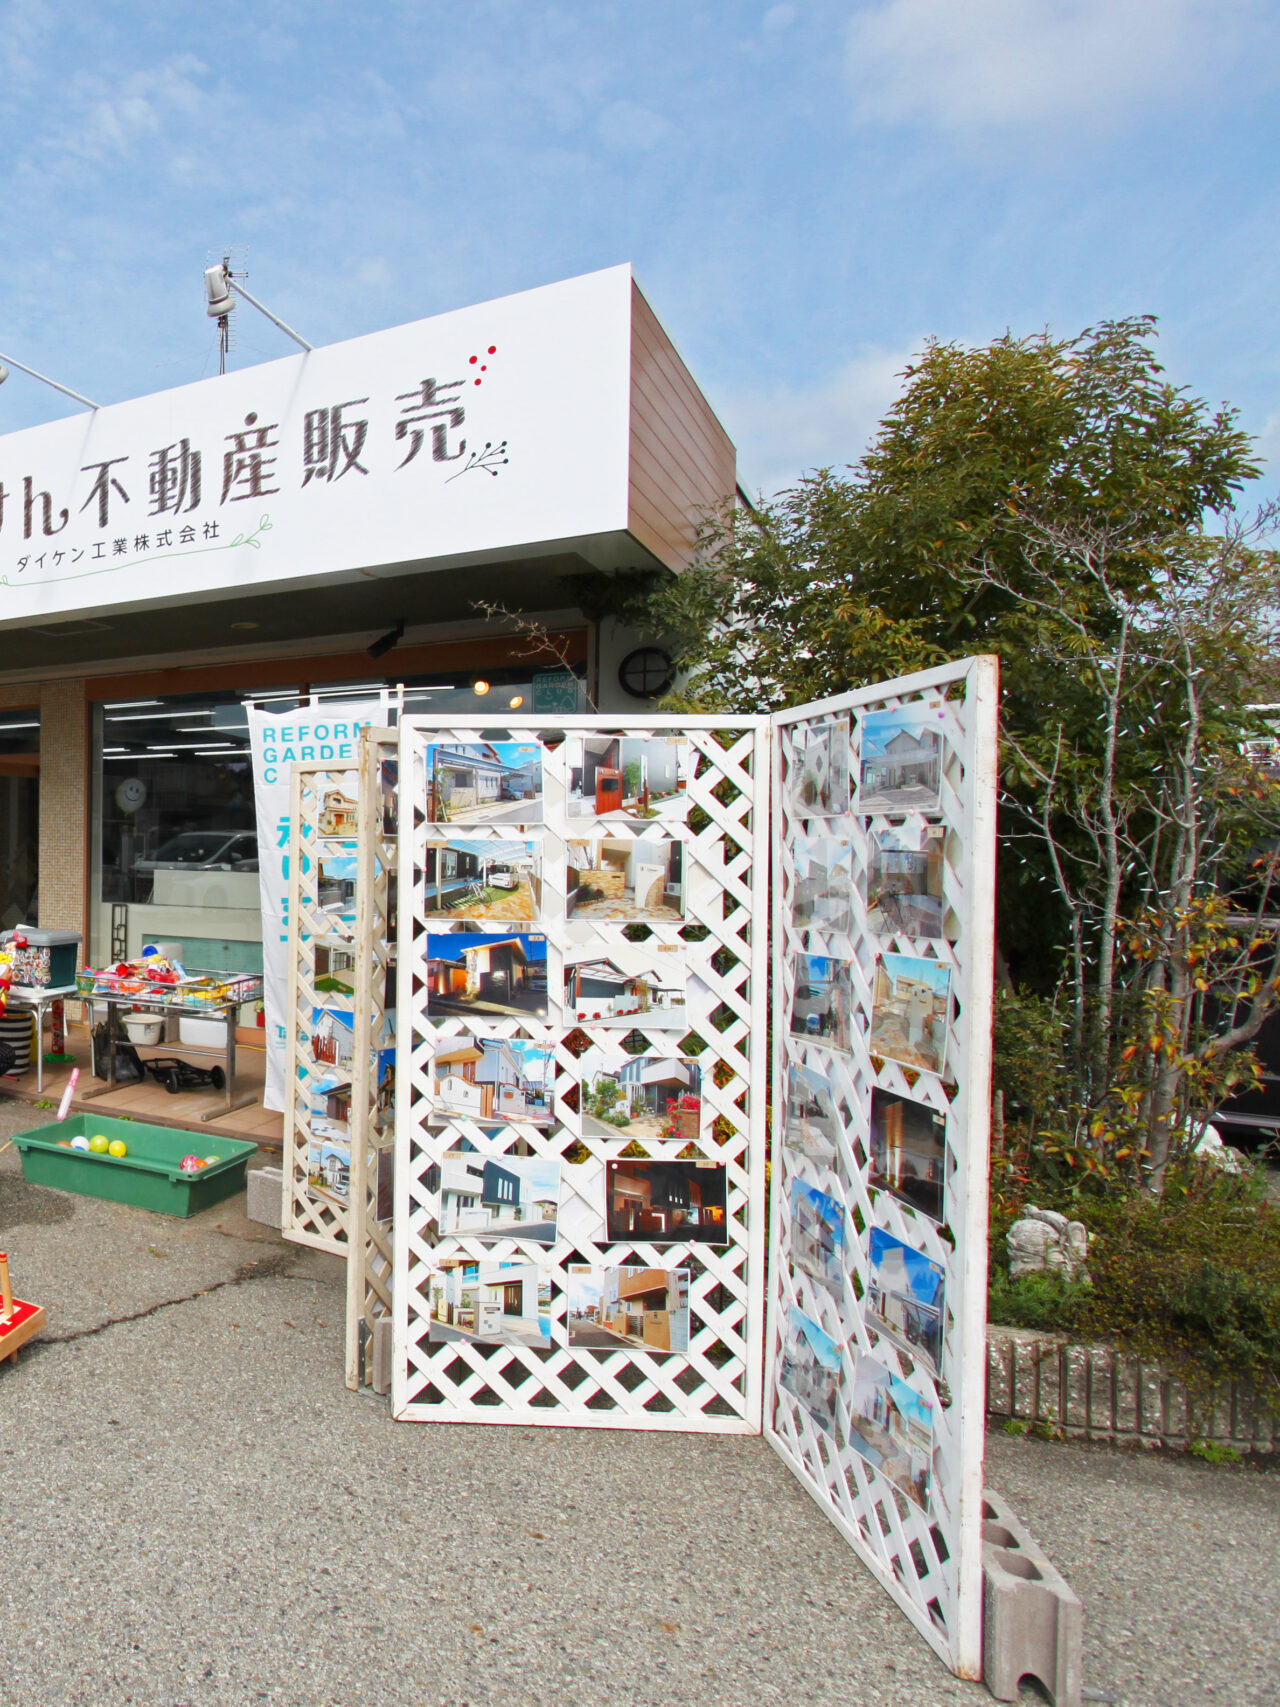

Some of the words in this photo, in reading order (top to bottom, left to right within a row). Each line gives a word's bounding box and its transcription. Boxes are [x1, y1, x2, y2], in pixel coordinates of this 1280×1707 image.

[17, 520, 220, 573] ダイケン工業株式会社
[263, 744, 352, 763] GARDE
